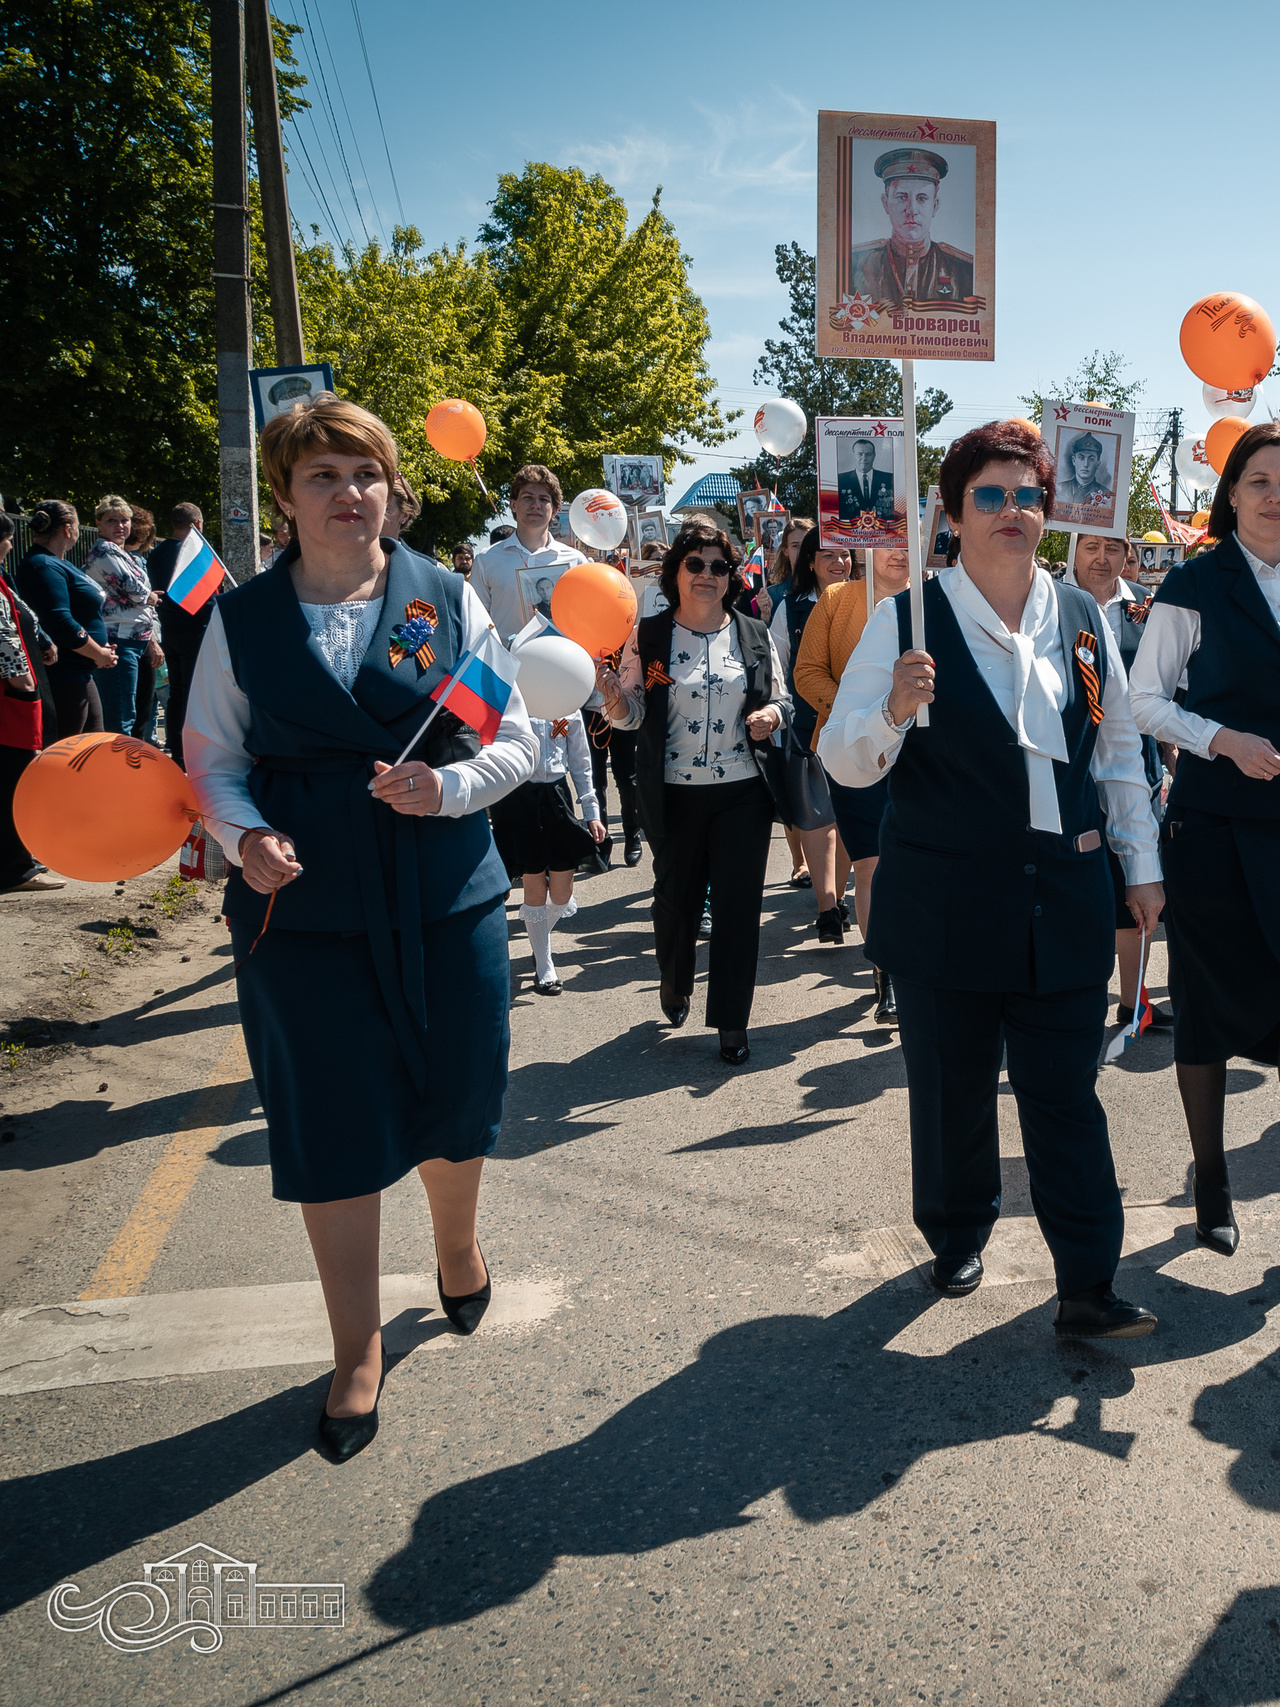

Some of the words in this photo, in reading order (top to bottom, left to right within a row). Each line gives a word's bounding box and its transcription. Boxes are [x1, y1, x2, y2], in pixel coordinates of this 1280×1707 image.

[892, 314, 981, 335] Броварец
[842, 331, 908, 346] Владимир
[909, 334, 989, 348] Тимофеевич
[894, 348, 917, 357] Герой
[918, 348, 962, 358] Советского
[963, 349, 988, 358] Союза
